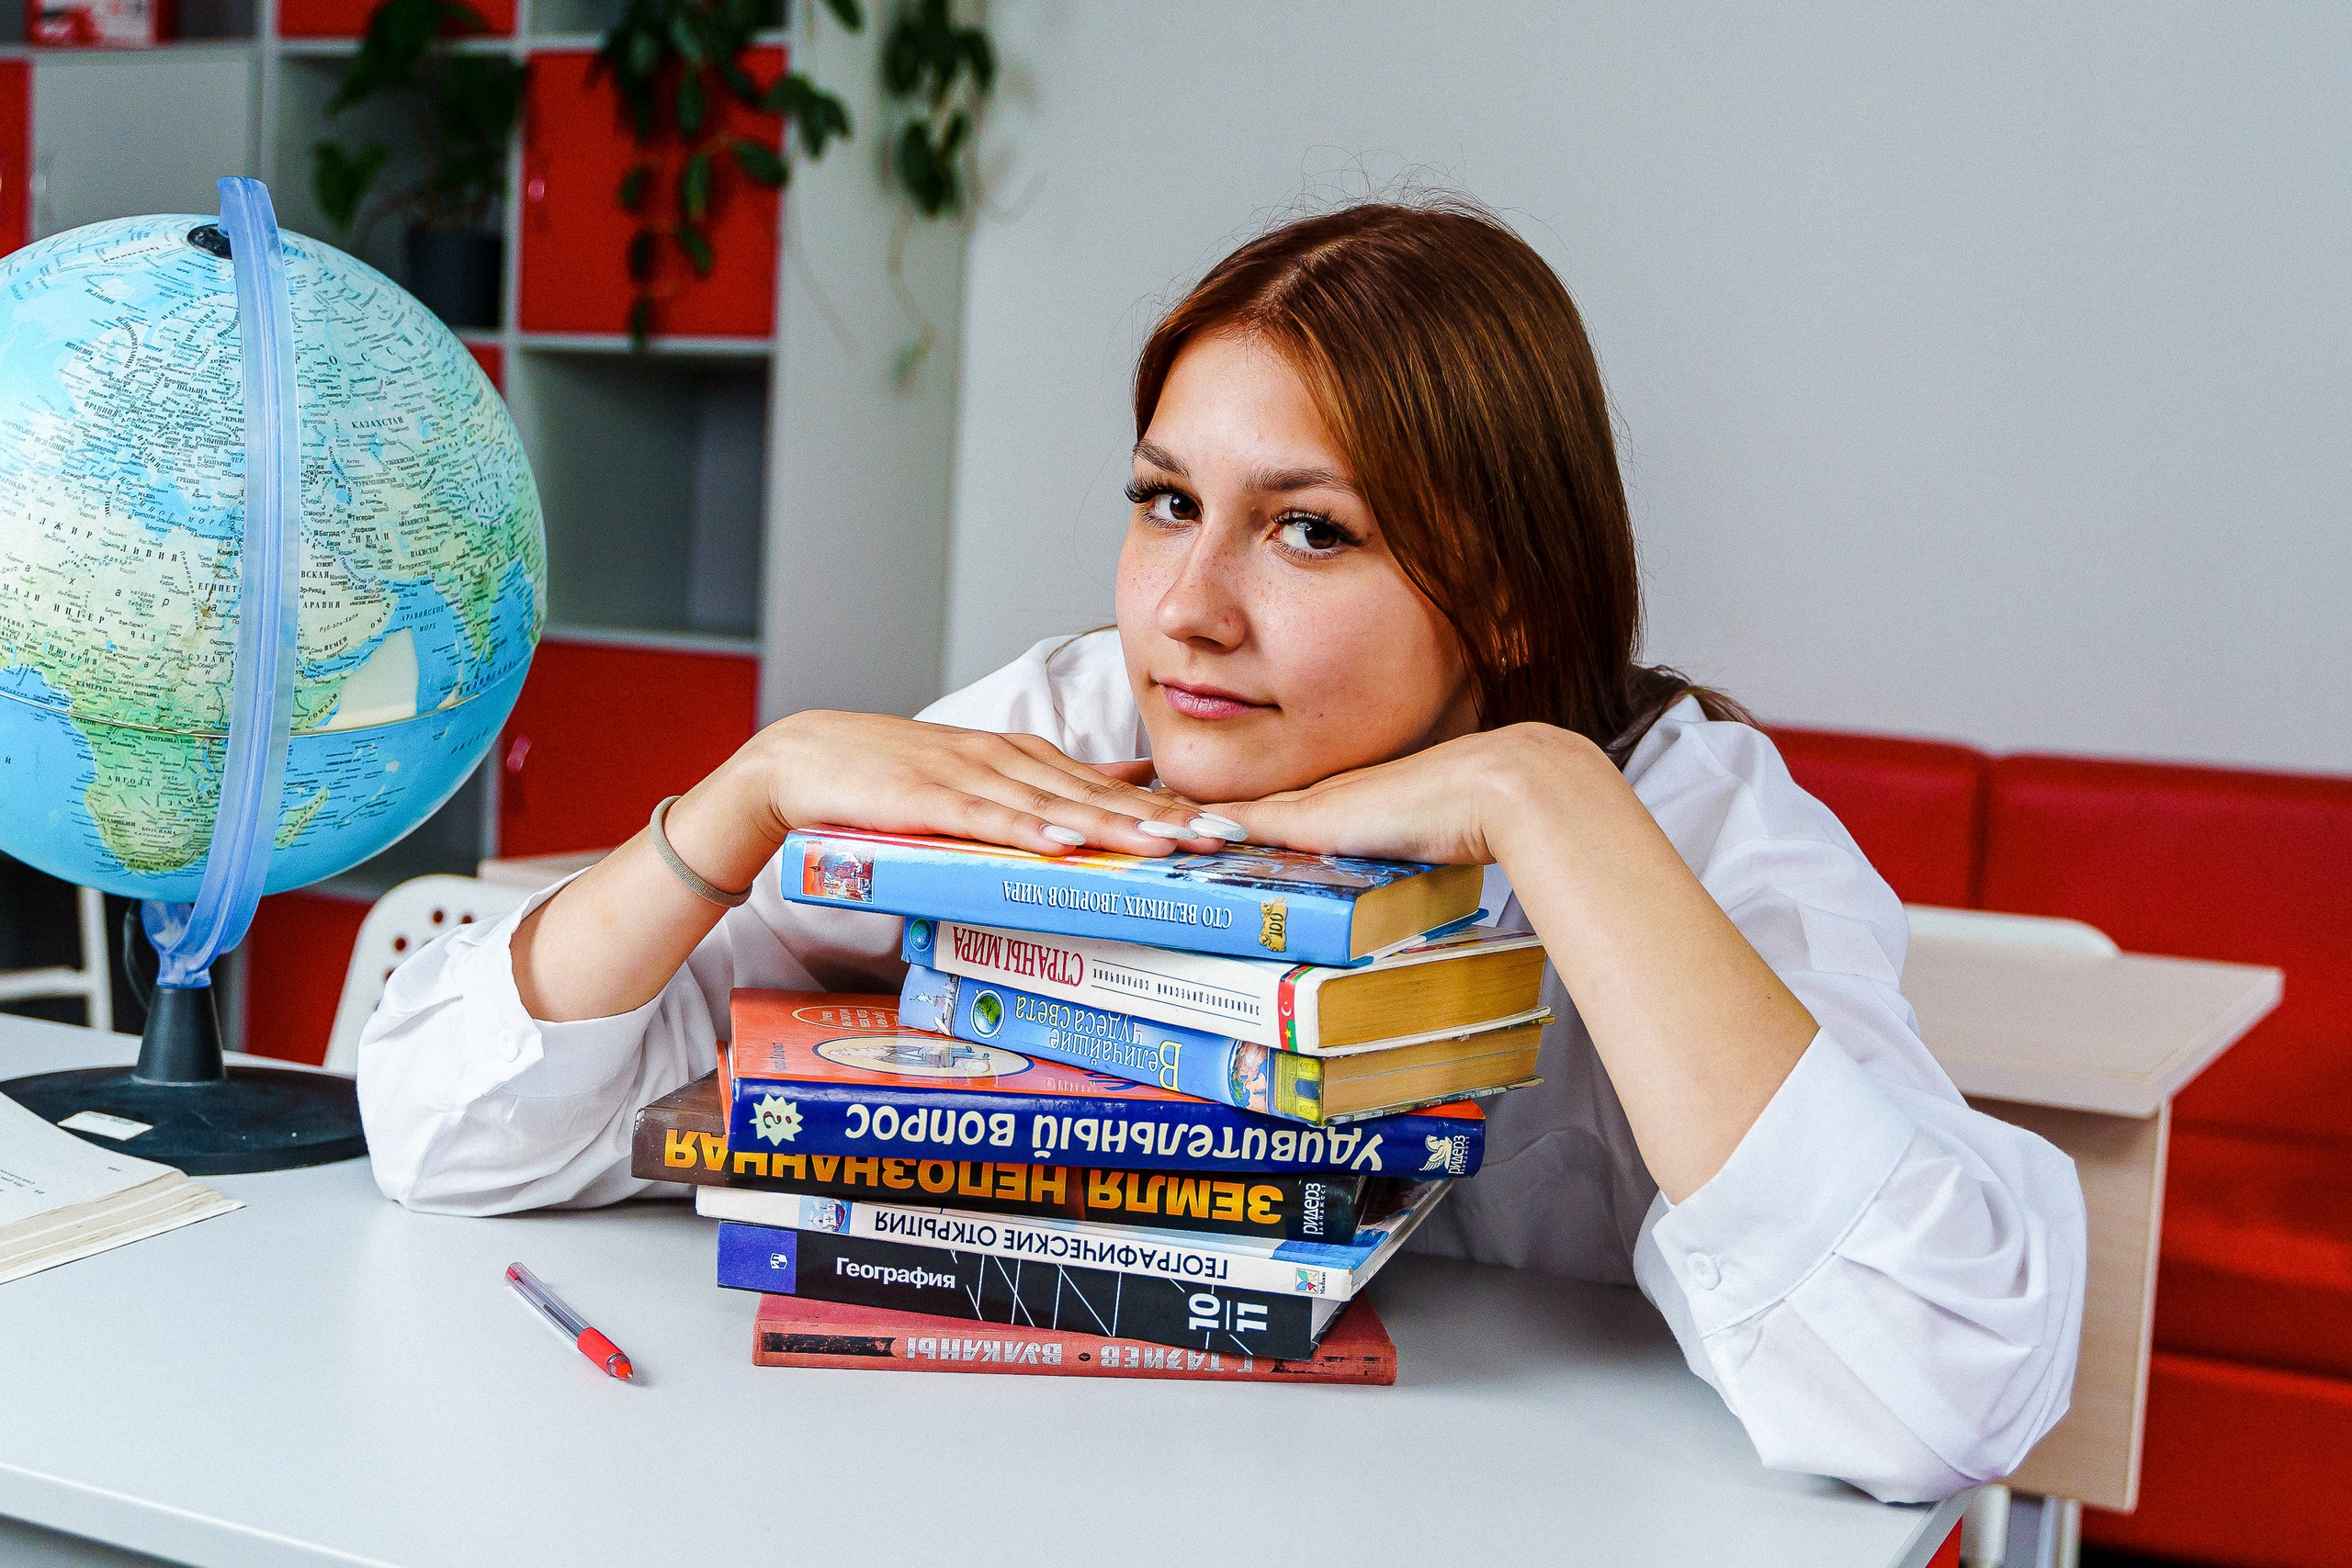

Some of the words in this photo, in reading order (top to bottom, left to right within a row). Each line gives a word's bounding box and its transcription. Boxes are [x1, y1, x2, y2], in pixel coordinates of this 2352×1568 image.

[351, 416, 404, 430] КАЗАХСТАН
[194, 532, 233, 541] Александрия
[120, 544, 177, 562] ЛИВИЯ
[198, 582, 238, 592] ЕГИПЕТ
[300, 570, 330, 579] ВСКАЯ
[1002, 879, 1044, 906] МИРА
[1047, 885, 1124, 917] ДВОРЦОВ
[1124, 896, 1199, 925] ВЕЛИКИХ
[1202, 907, 1233, 930] СТО
[1269, 912, 1283, 939] 100
[953, 926, 1004, 965] МИРА
[1005, 939, 1084, 987] СТРАНЫ
[1091, 968, 1149, 991] СПРАВОЧНИК
[1014, 995, 1070, 1028] света
[1157, 983, 1260, 1016] ЭНЦИКЛОПЕДИЧЕСКИЙ
[1048, 1027, 1182, 1091] Величайшие
[664, 1128, 1068, 1203] НЕПОЗНАННАЯ
[1448, 1134, 1466, 1175] ридерз
[1088, 1168, 1283, 1224] ЗЕМЛЯ
[1303, 1182, 1324, 1235] ридерз
[875, 1210, 998, 1246] ОТКРЫТИЯ
[1003, 1228, 1228, 1280] ГЕОГРАФИЧЕСКИЕ
[835, 1257, 956, 1289] География
[1189, 1292, 1221, 1331] 10
[1236, 1301, 1268, 1332] 11
[907, 1337, 1063, 1366] ВУЛКАНЫ
[1101, 1345, 1225, 1372] ТАЗИЕВ
